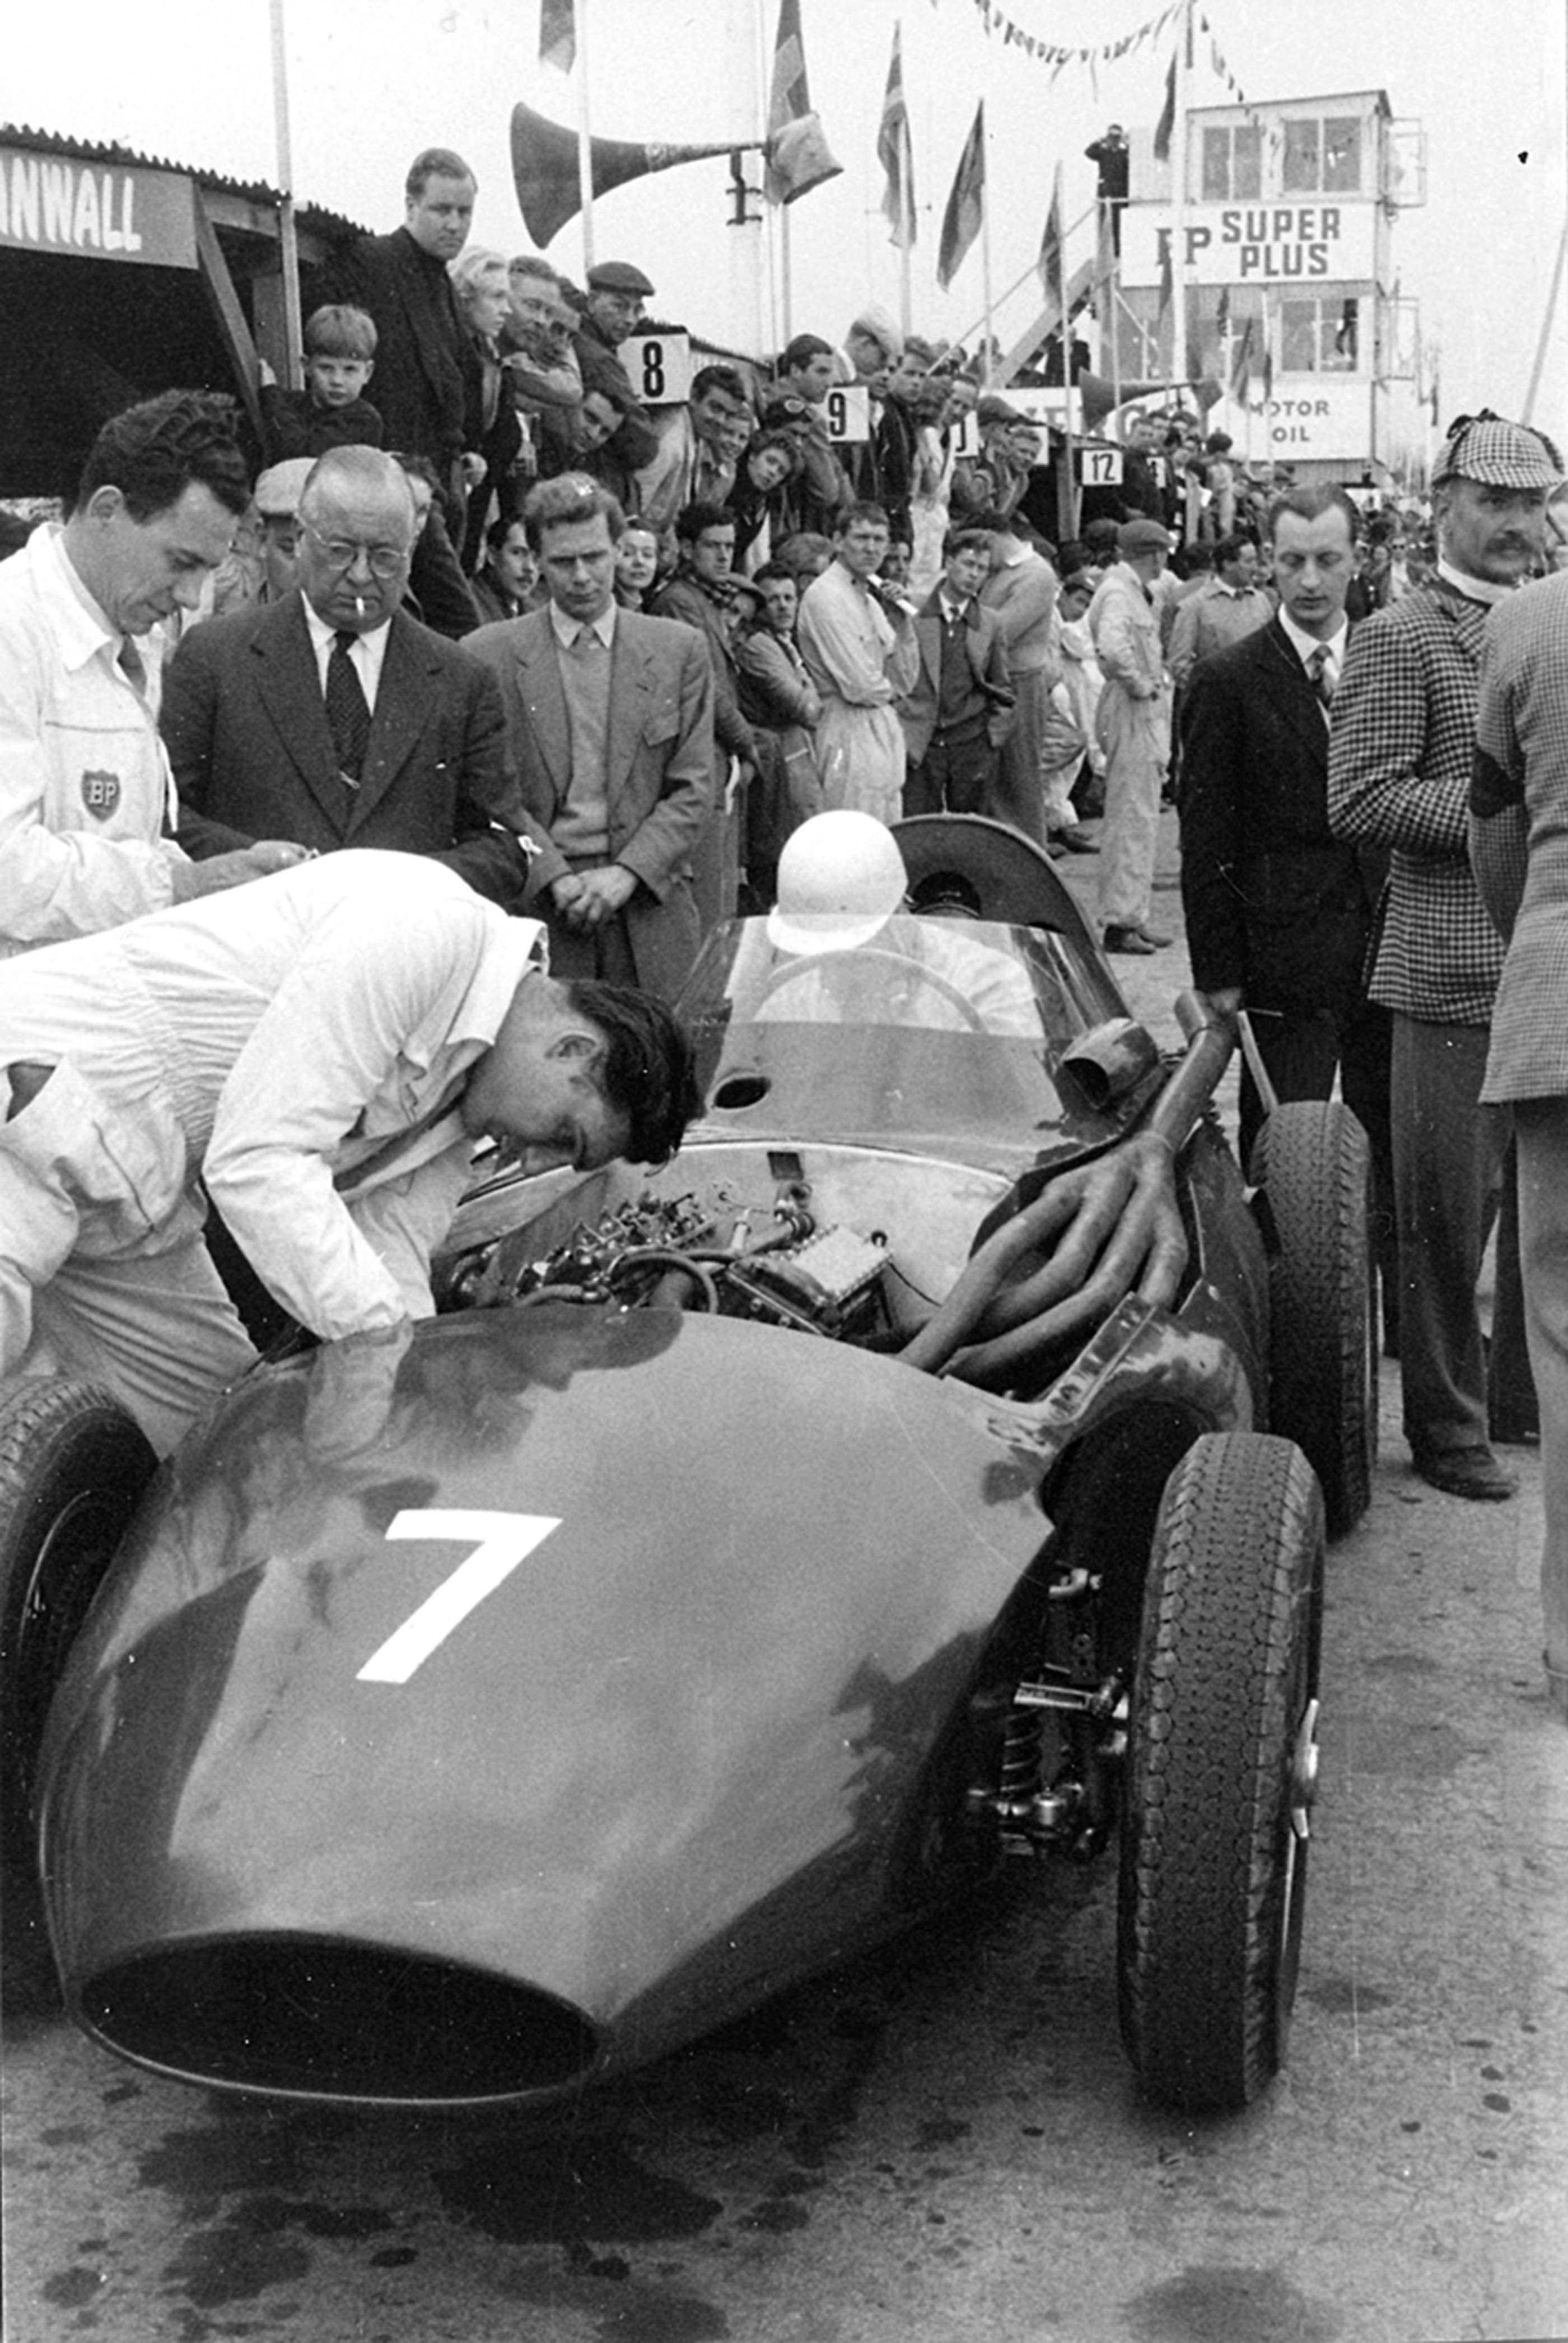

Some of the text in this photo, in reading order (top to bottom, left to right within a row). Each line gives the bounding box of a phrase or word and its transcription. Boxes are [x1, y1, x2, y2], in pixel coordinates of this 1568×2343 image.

[1221, 208, 1340, 243] SUPER
[1240, 243, 1328, 277] PLUS
[642, 341, 665, 398] 8
[828, 392, 847, 437] 9
[1272, 426, 1311, 443] OIL
[1092, 453, 1116, 482] 12
[89, 779, 116, 806] BP
[354, 1508, 564, 1684] 7
